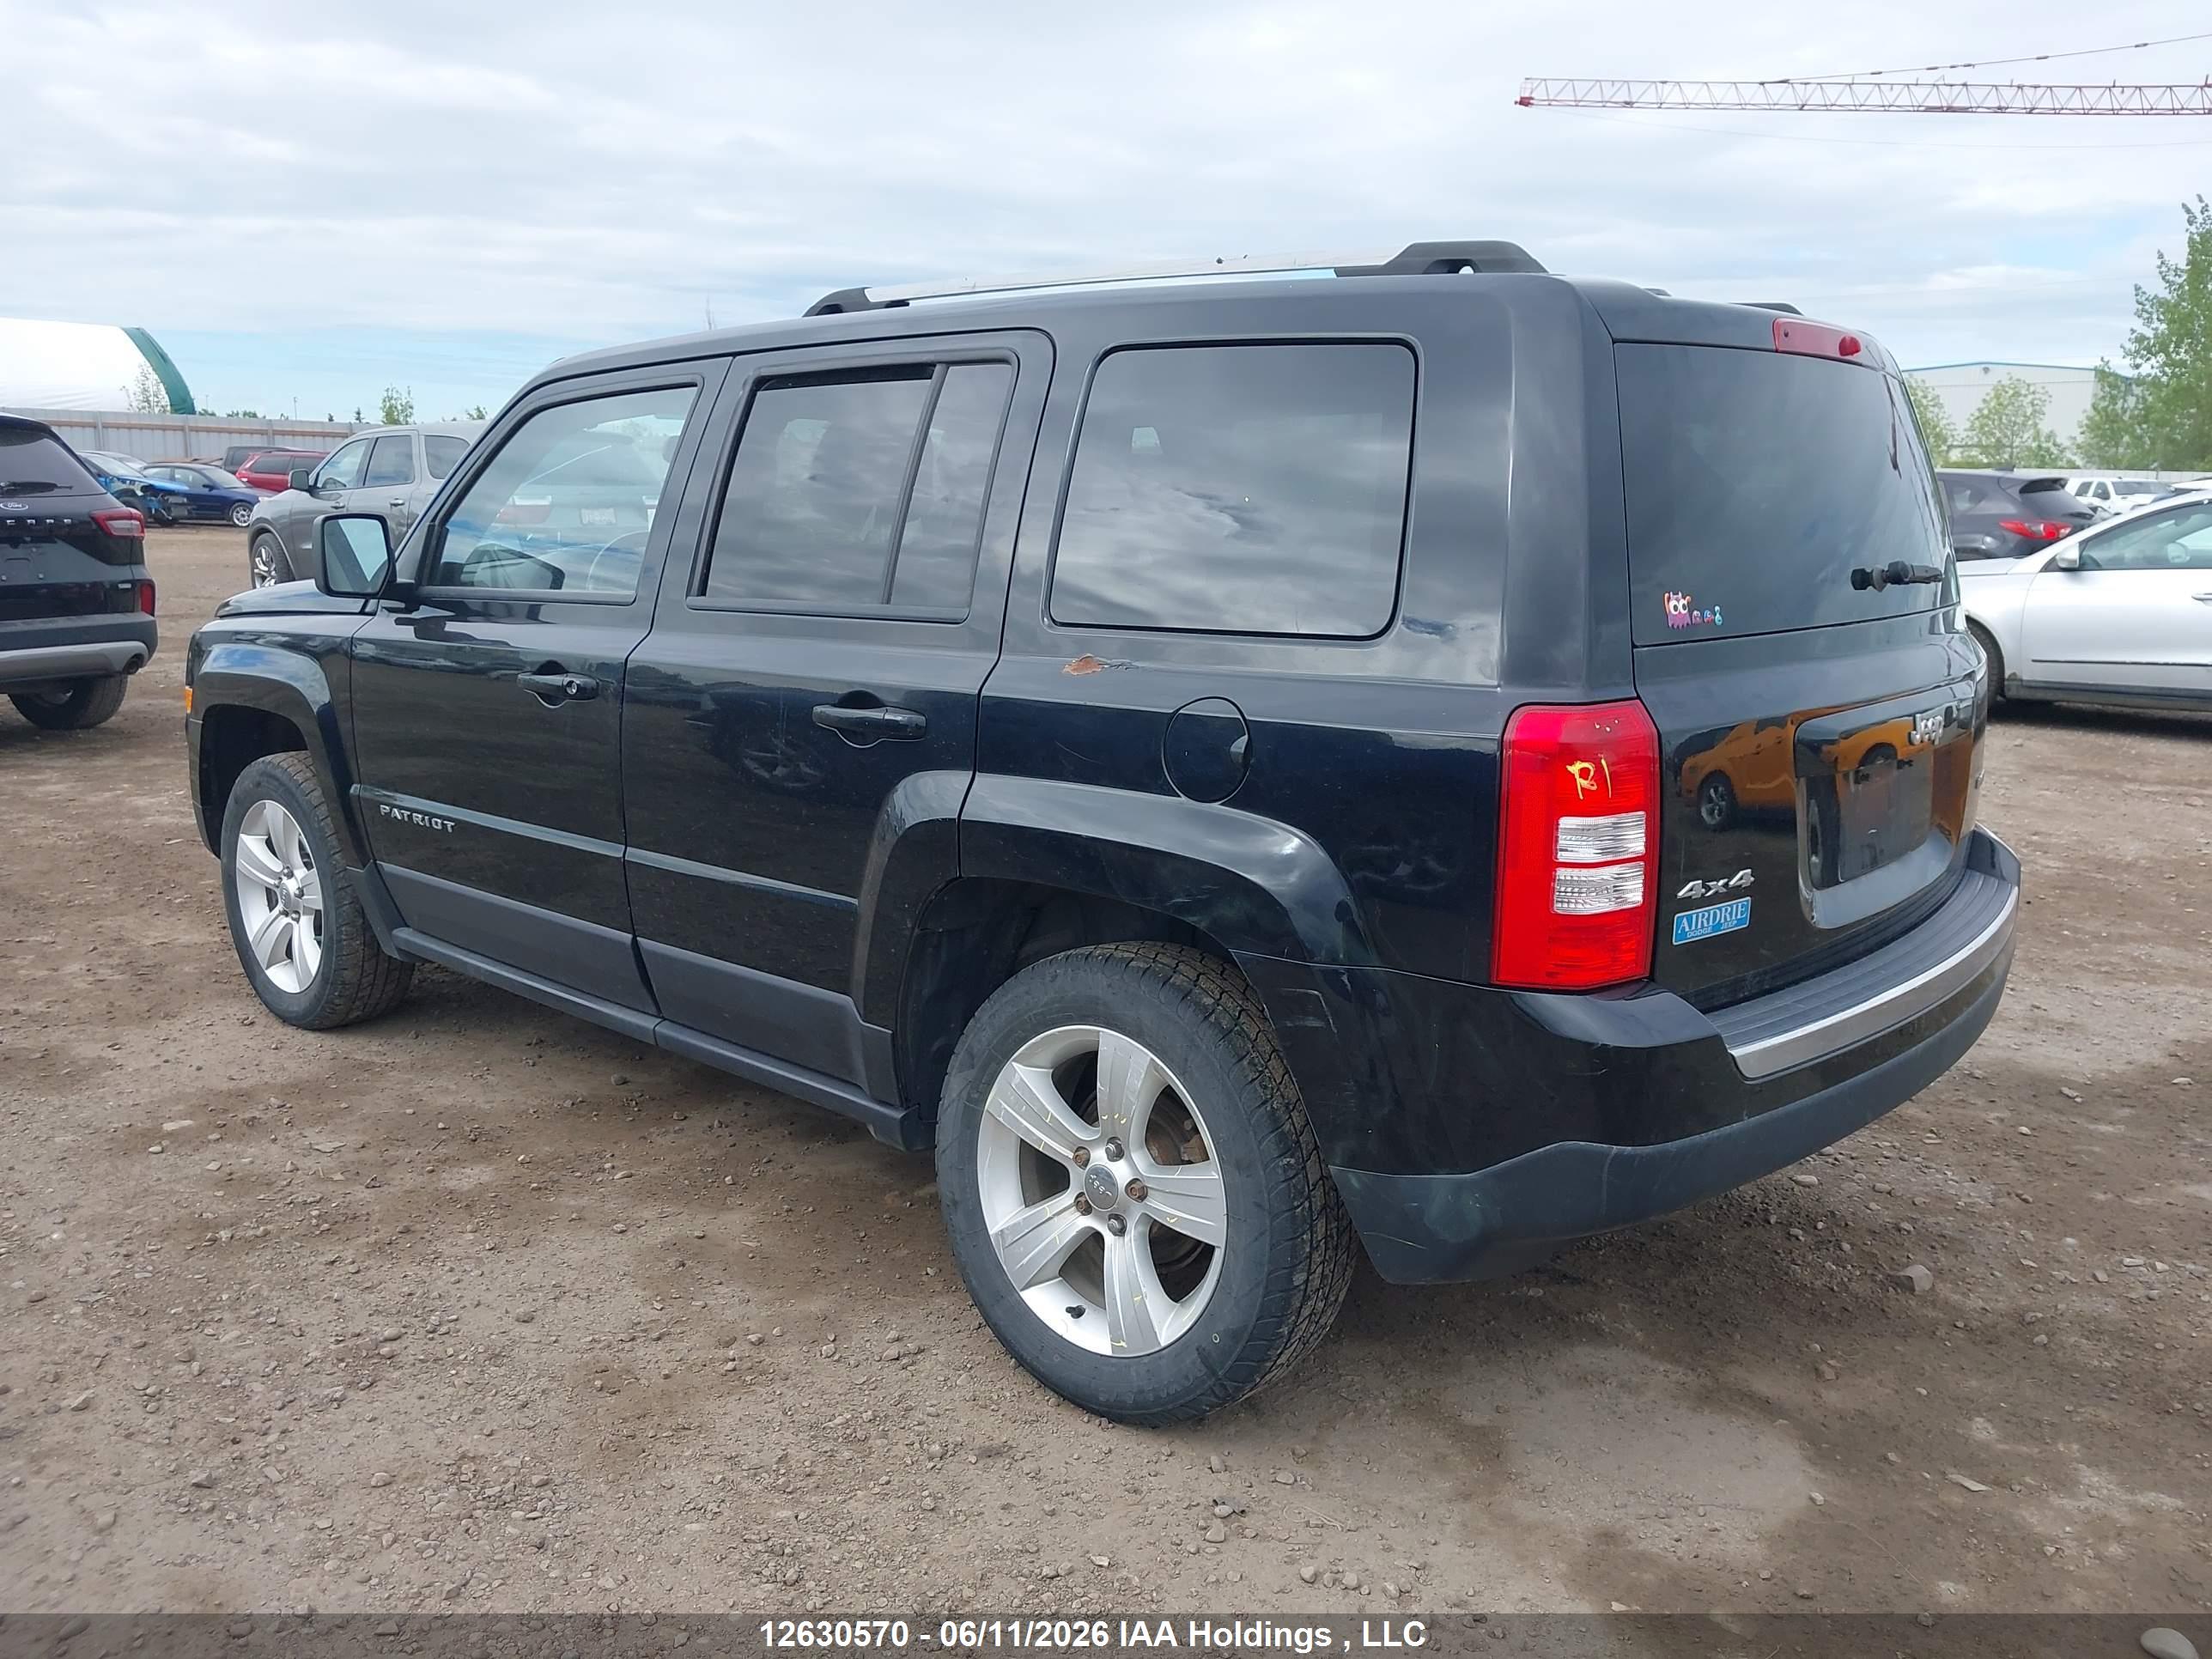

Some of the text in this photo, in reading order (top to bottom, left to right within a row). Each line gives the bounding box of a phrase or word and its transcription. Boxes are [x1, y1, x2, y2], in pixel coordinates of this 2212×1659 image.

[1911, 714, 1945, 745] Jeep
[380, 804, 455, 833] PATRIOT
[1676, 868, 1755, 900] 4x4
[1677, 901, 1747, 933] AIRDRIE
[1686, 919, 1738, 939] DODGE JEEP
